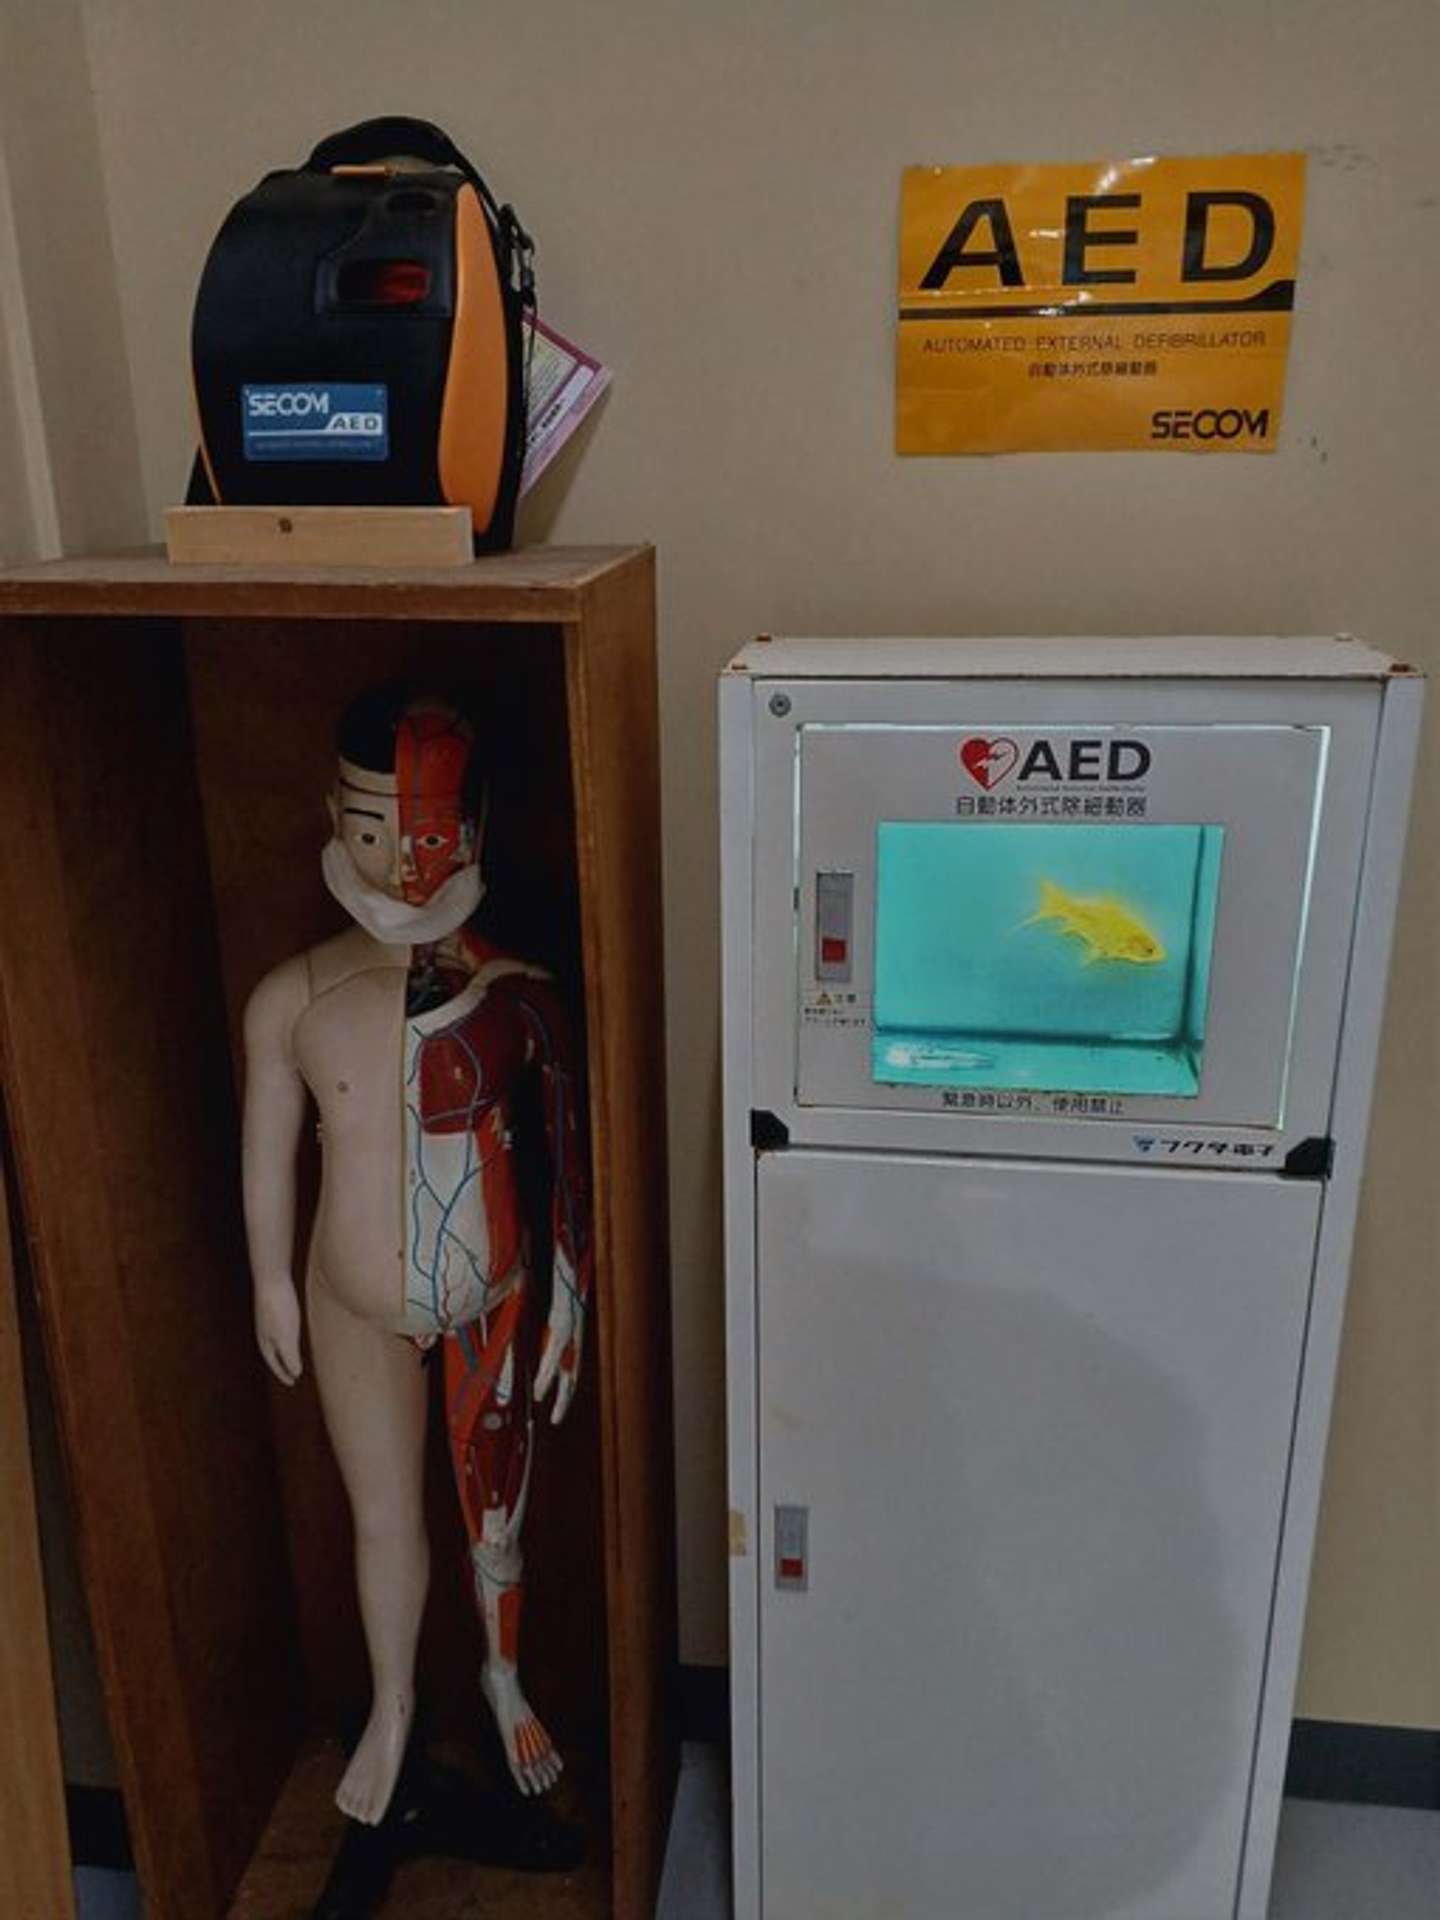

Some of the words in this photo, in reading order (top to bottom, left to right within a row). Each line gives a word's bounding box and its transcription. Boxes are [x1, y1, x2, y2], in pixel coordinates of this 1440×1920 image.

[918, 191, 1275, 290] AED
[923, 336, 1026, 353] AUTOMATED
[1036, 334, 1122, 351] EXTERNAL
[1133, 330, 1267, 349] DEFIBRILLATOR
[248, 392, 329, 416] SECOM
[332, 416, 379, 431] AED
[1150, 408, 1269, 440] SECOM
[1017, 739, 1152, 781] AED
[957, 795, 1148, 817] 自動体外式除細動器
